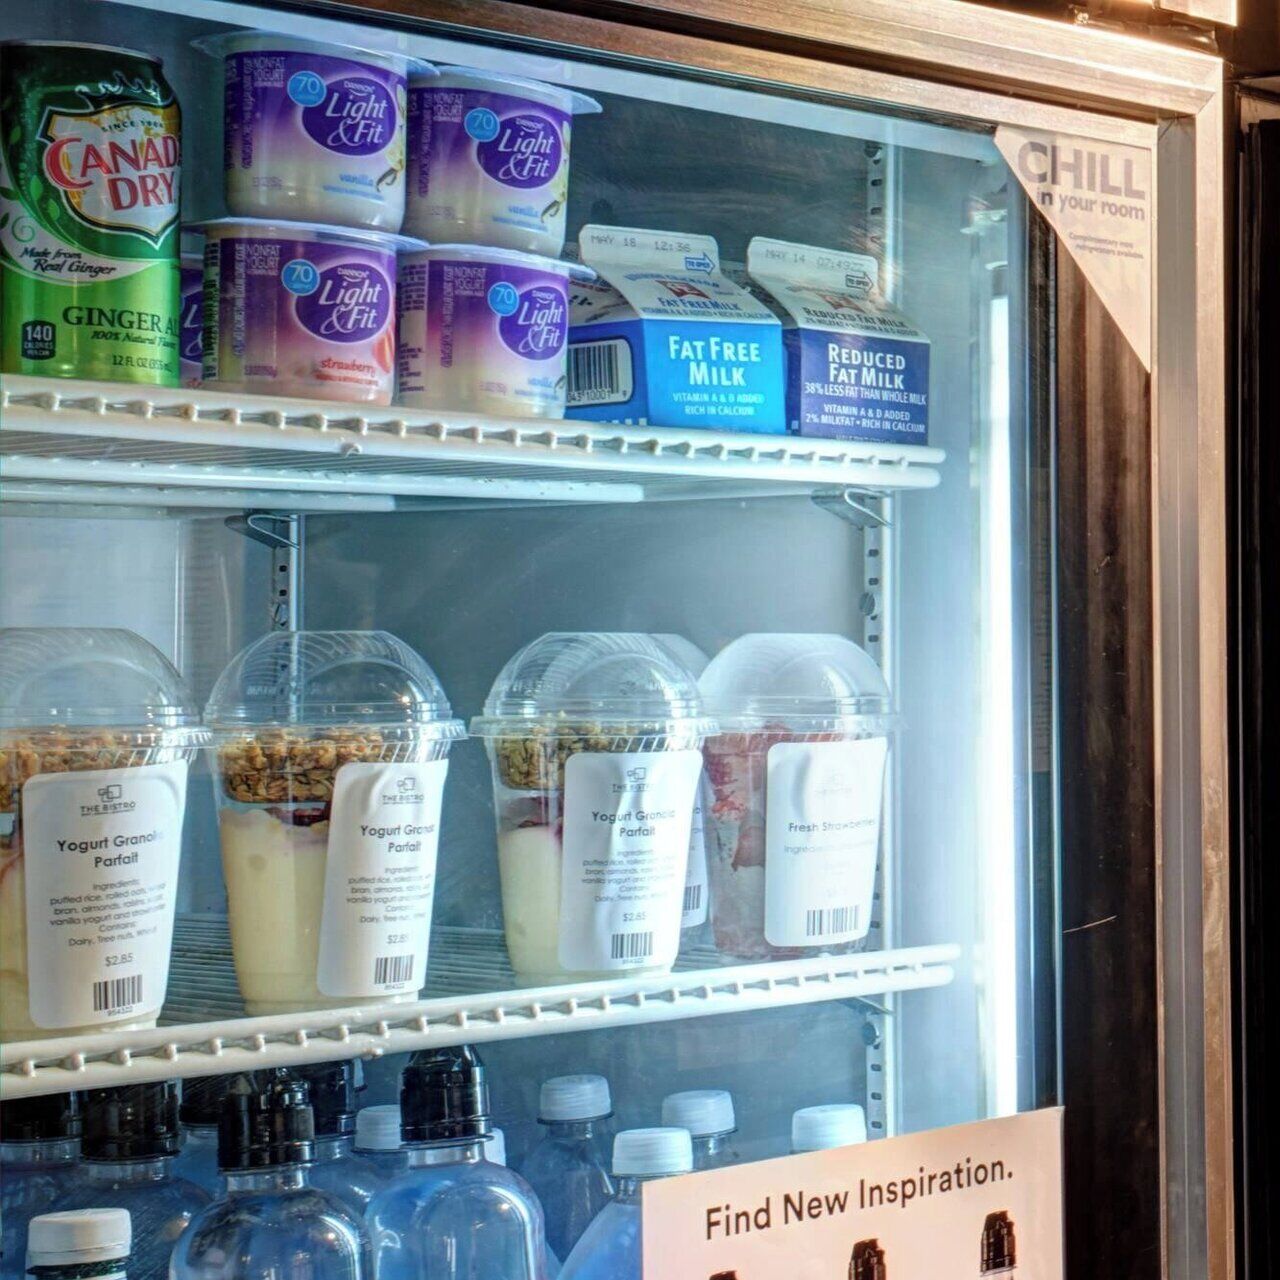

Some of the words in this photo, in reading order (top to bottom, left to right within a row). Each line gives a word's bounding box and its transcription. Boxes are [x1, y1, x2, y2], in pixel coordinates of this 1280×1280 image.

[295, 77, 320, 94] 70
[326, 92, 388, 124] Light
[473, 113, 494, 130] 70
[498, 128, 555, 159] Light
[1018, 141, 1145, 200] CHILL
[108, 172, 175, 212] DRY
[1037, 186, 1053, 206] in
[1059, 194, 1097, 213] your
[1102, 201, 1145, 220] room
[290, 265, 312, 282] 70
[319, 280, 382, 311] Light
[62, 305, 161, 333] GINGER
[518, 301, 564, 331] Light
[26, 325, 53, 343] 140
[668, 335, 705, 361] FAT
[709, 337, 761, 362] FREE
[828, 342, 906, 370] REDUCED
[829, 364, 857, 385] FAT
[862, 367, 905, 390] MILK
[360, 825, 401, 839] Yogurt
[94, 851, 139, 868] Parfait
[388, 842, 422, 853] Parfait
[105, 953, 134, 968] $2.85
[706, 1202, 773, 1241] Find
[783, 1188, 849, 1223] New
[858, 1156, 1015, 1211] Inspiration.
